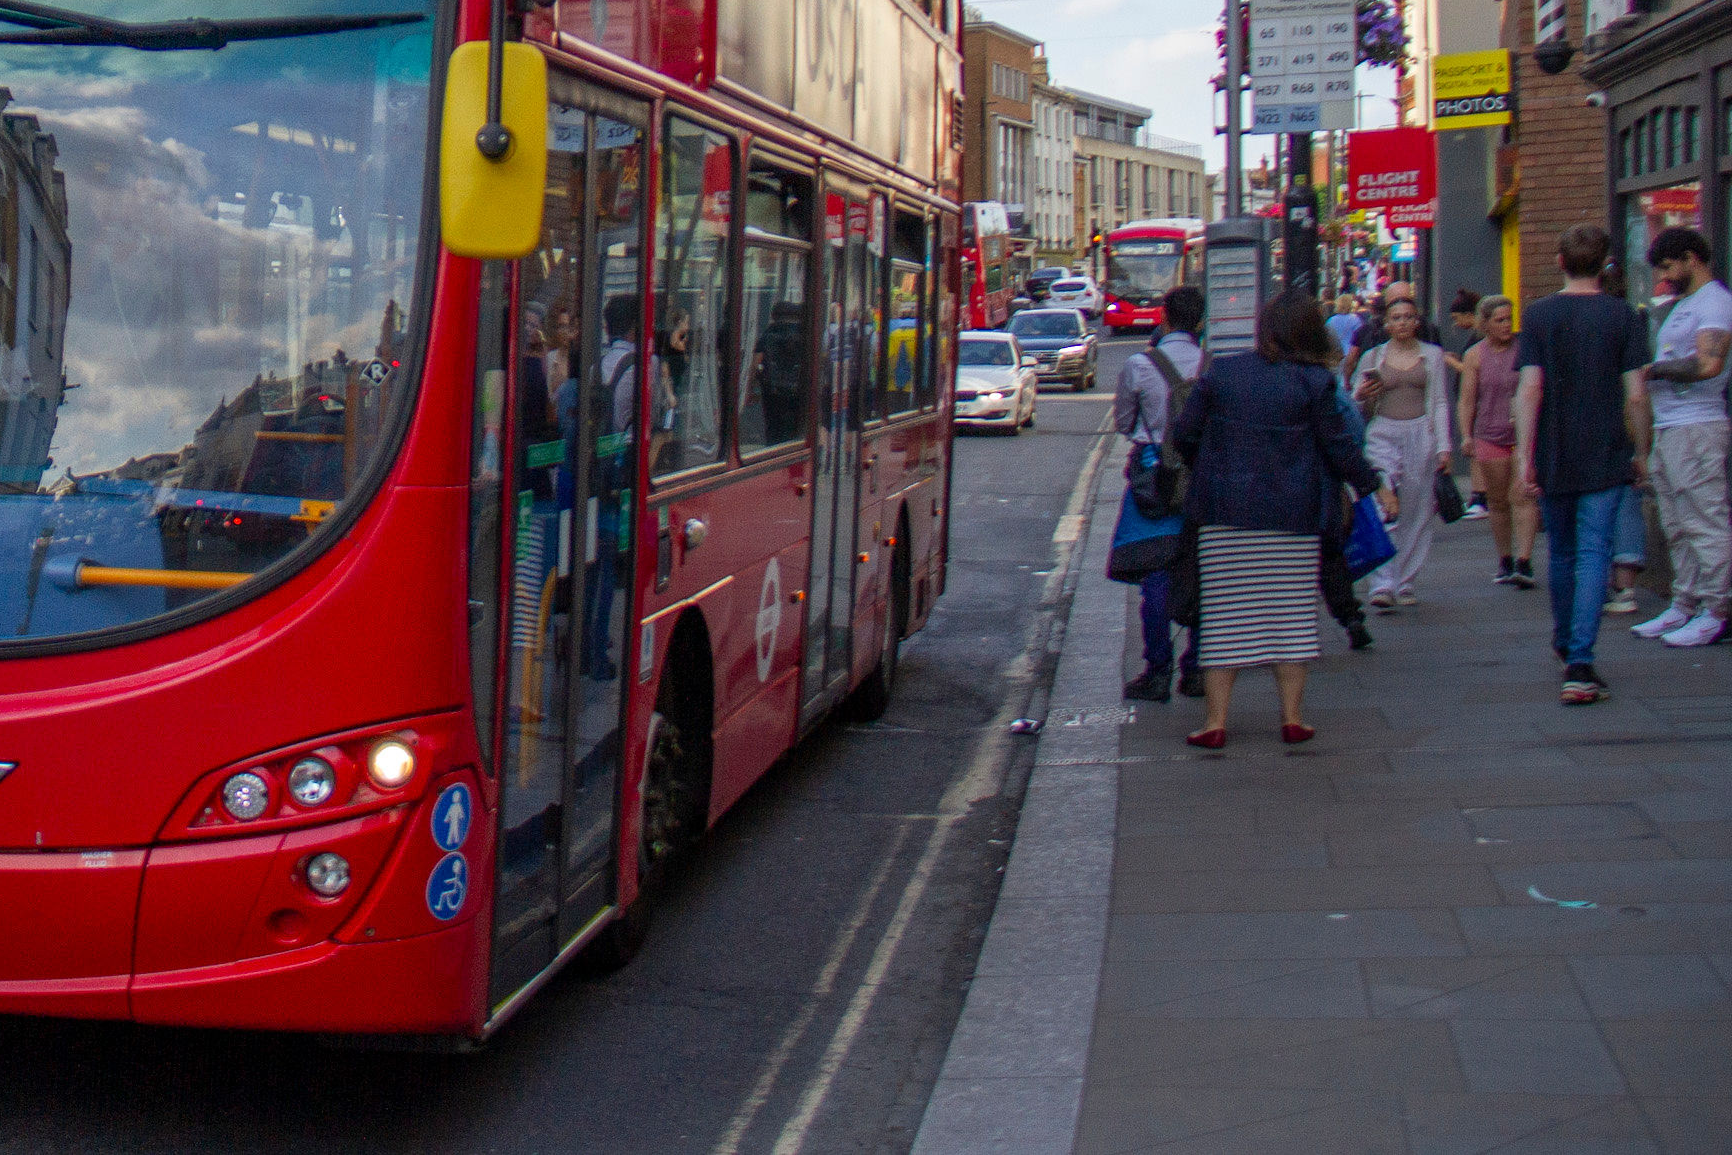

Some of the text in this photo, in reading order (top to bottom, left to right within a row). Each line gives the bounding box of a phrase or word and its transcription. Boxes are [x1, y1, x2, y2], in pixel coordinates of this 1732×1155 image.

[1259, 22, 1349, 39] 65 110 190
[1257, 51, 1349, 67] 371 419 490
[1435, 61, 1505, 77] PASSPORT &
[1256, 80, 1350, 97] H37 R68 R70
[1436, 95, 1507, 115] PHOTOS
[1256, 111, 1315, 125] N22 N65
[1357, 169, 1420, 187] FLIGHT
[1356, 184, 1420, 201] CENTRE
